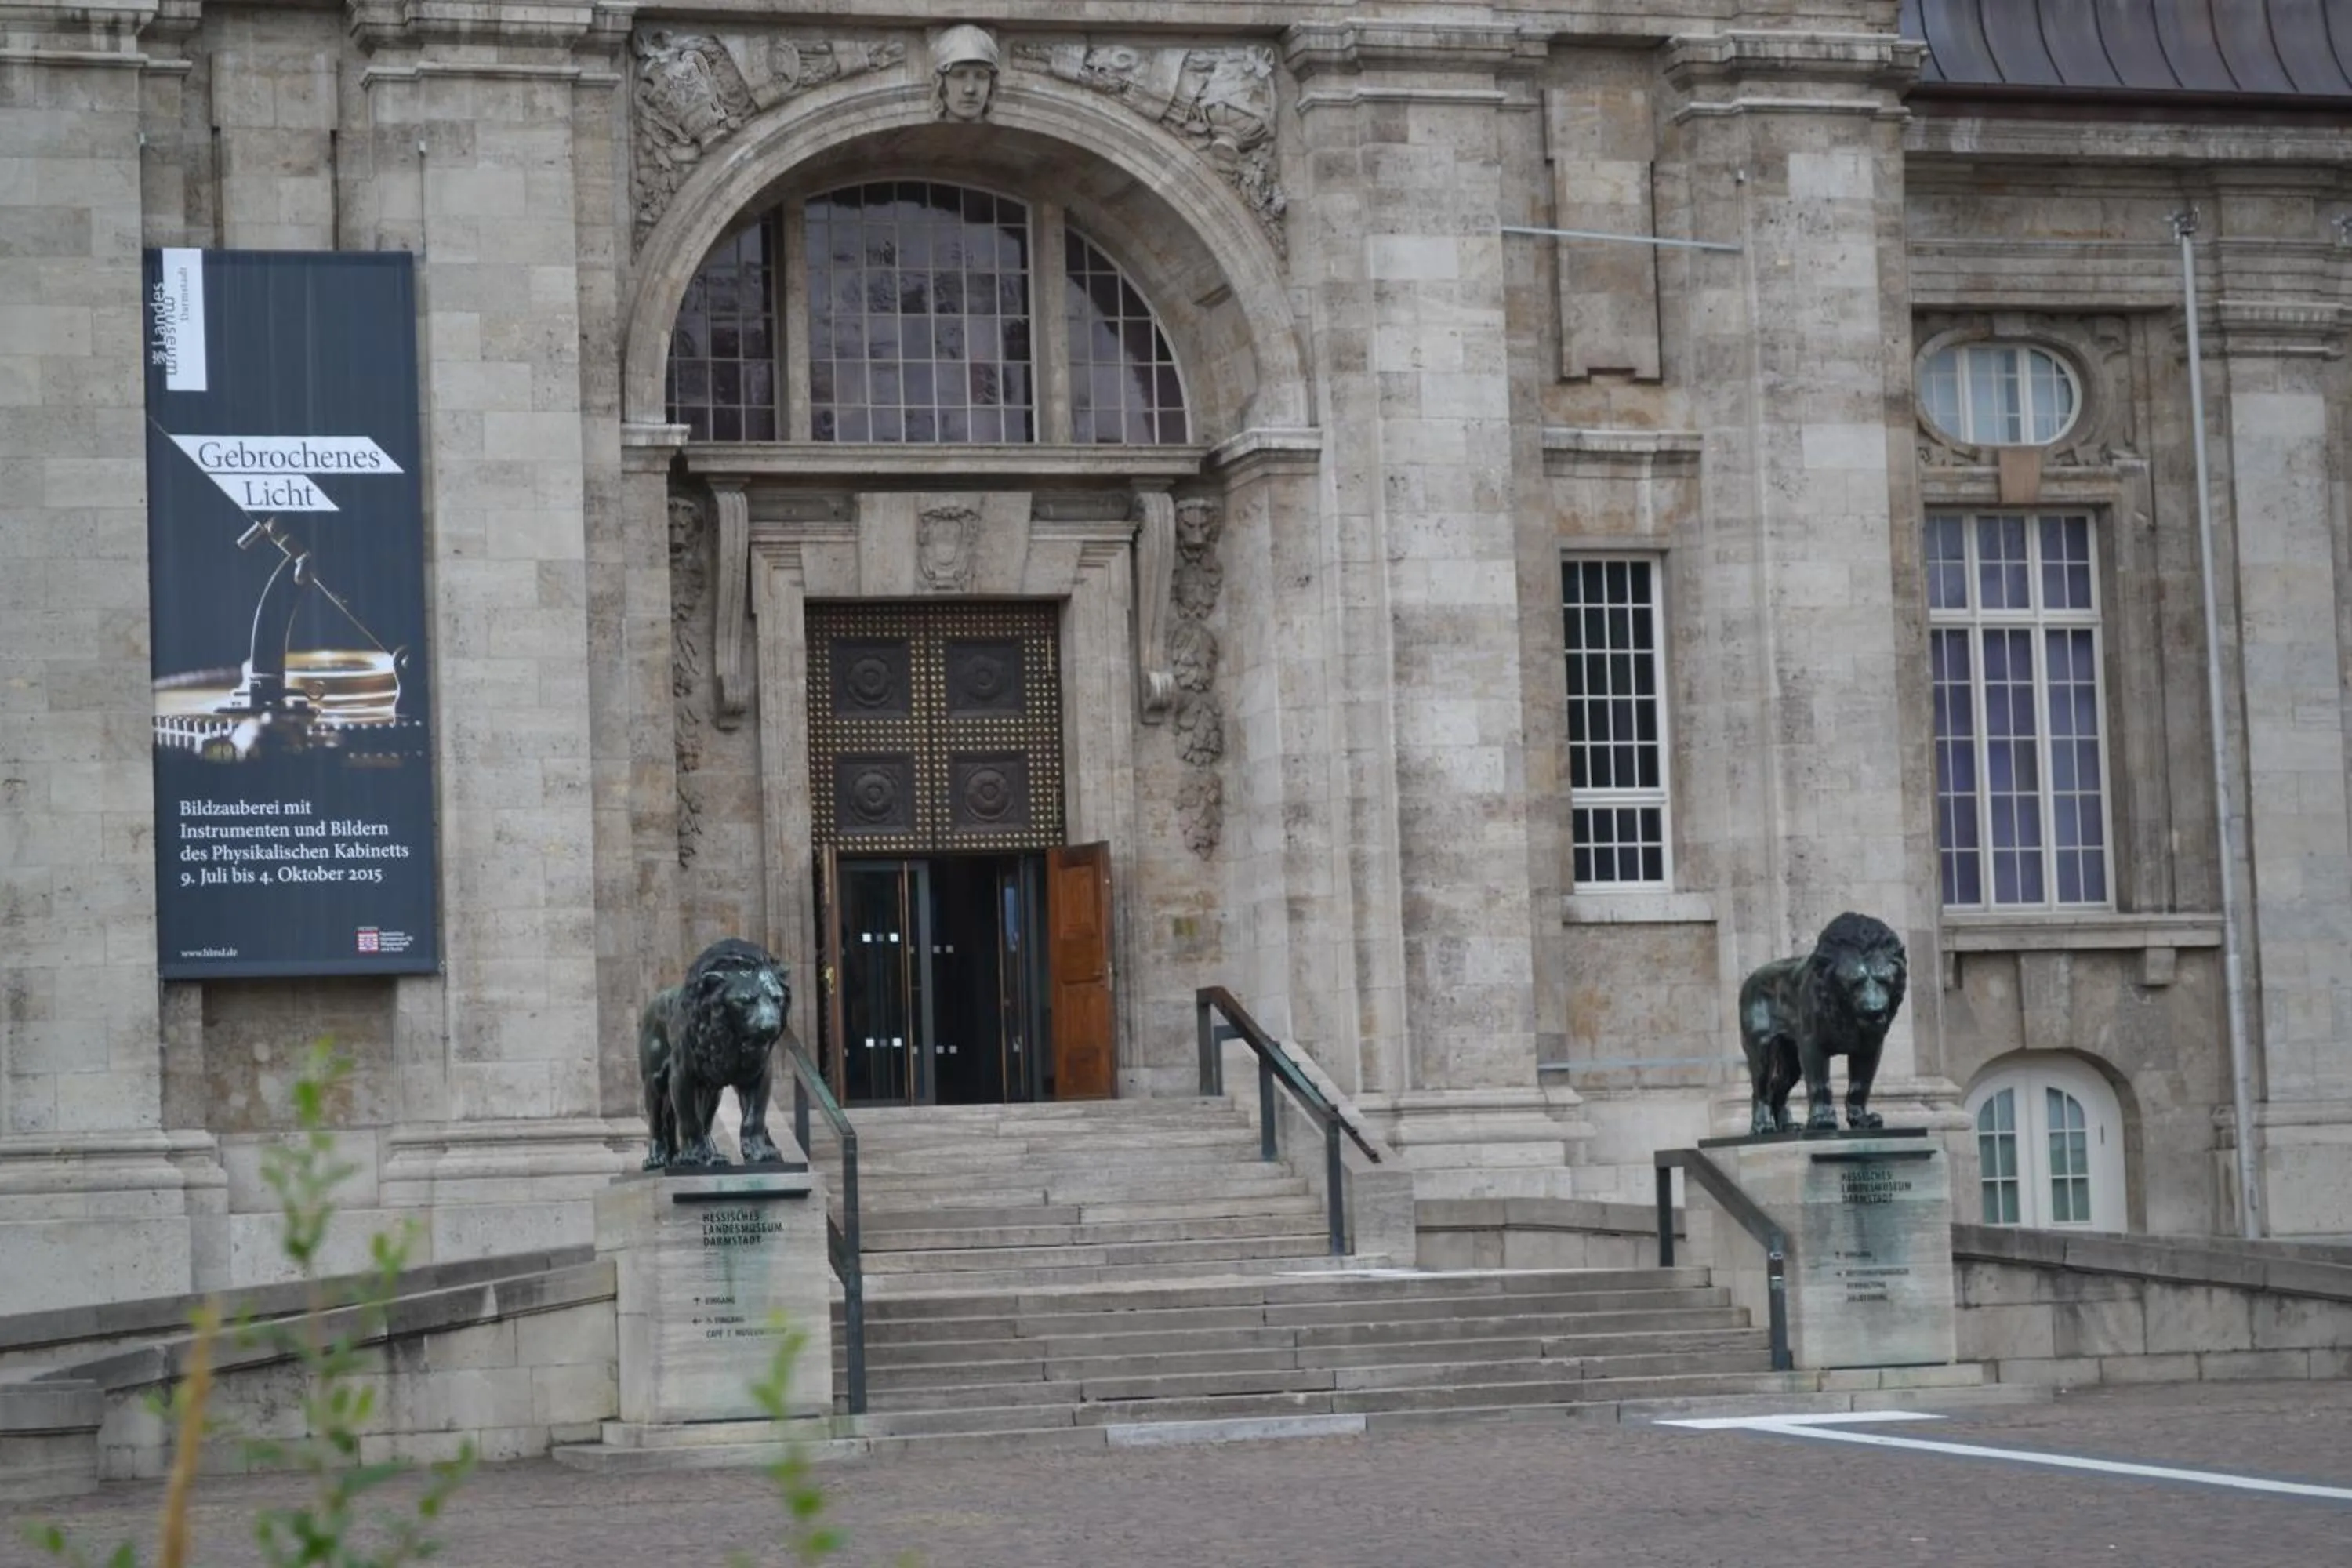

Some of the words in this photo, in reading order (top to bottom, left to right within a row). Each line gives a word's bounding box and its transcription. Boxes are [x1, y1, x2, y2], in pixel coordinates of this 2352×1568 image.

[150, 281, 165, 346] Landes
[165, 296, 178, 376] museum
[198, 441, 381, 469] Gebrochenes
[243, 476, 314, 507] Licht
[180, 800, 279, 816] Bildzauberei
[285, 800, 313, 815] mit
[180, 823, 290, 839] Instrumenten
[294, 820, 326, 837] und
[330, 820, 389, 837] Bildern
[180, 845, 208, 862] des
[212, 843, 329, 864] Physikalischen
[334, 842, 409, 858] Kabinetts
[180, 872, 195, 887] 9.
[200, 867, 227, 887] Juli
[232, 867, 255, 884] bis
[259, 870, 274, 886] 4.
[278, 866, 345, 883] Oktober
[348, 868, 383, 883] 2015
[702, 1210, 760, 1222] HESSISCHES
[702, 1222, 783, 1235] LANDESMUSEUM
[703, 1235, 761, 1247] DARMSTADT
